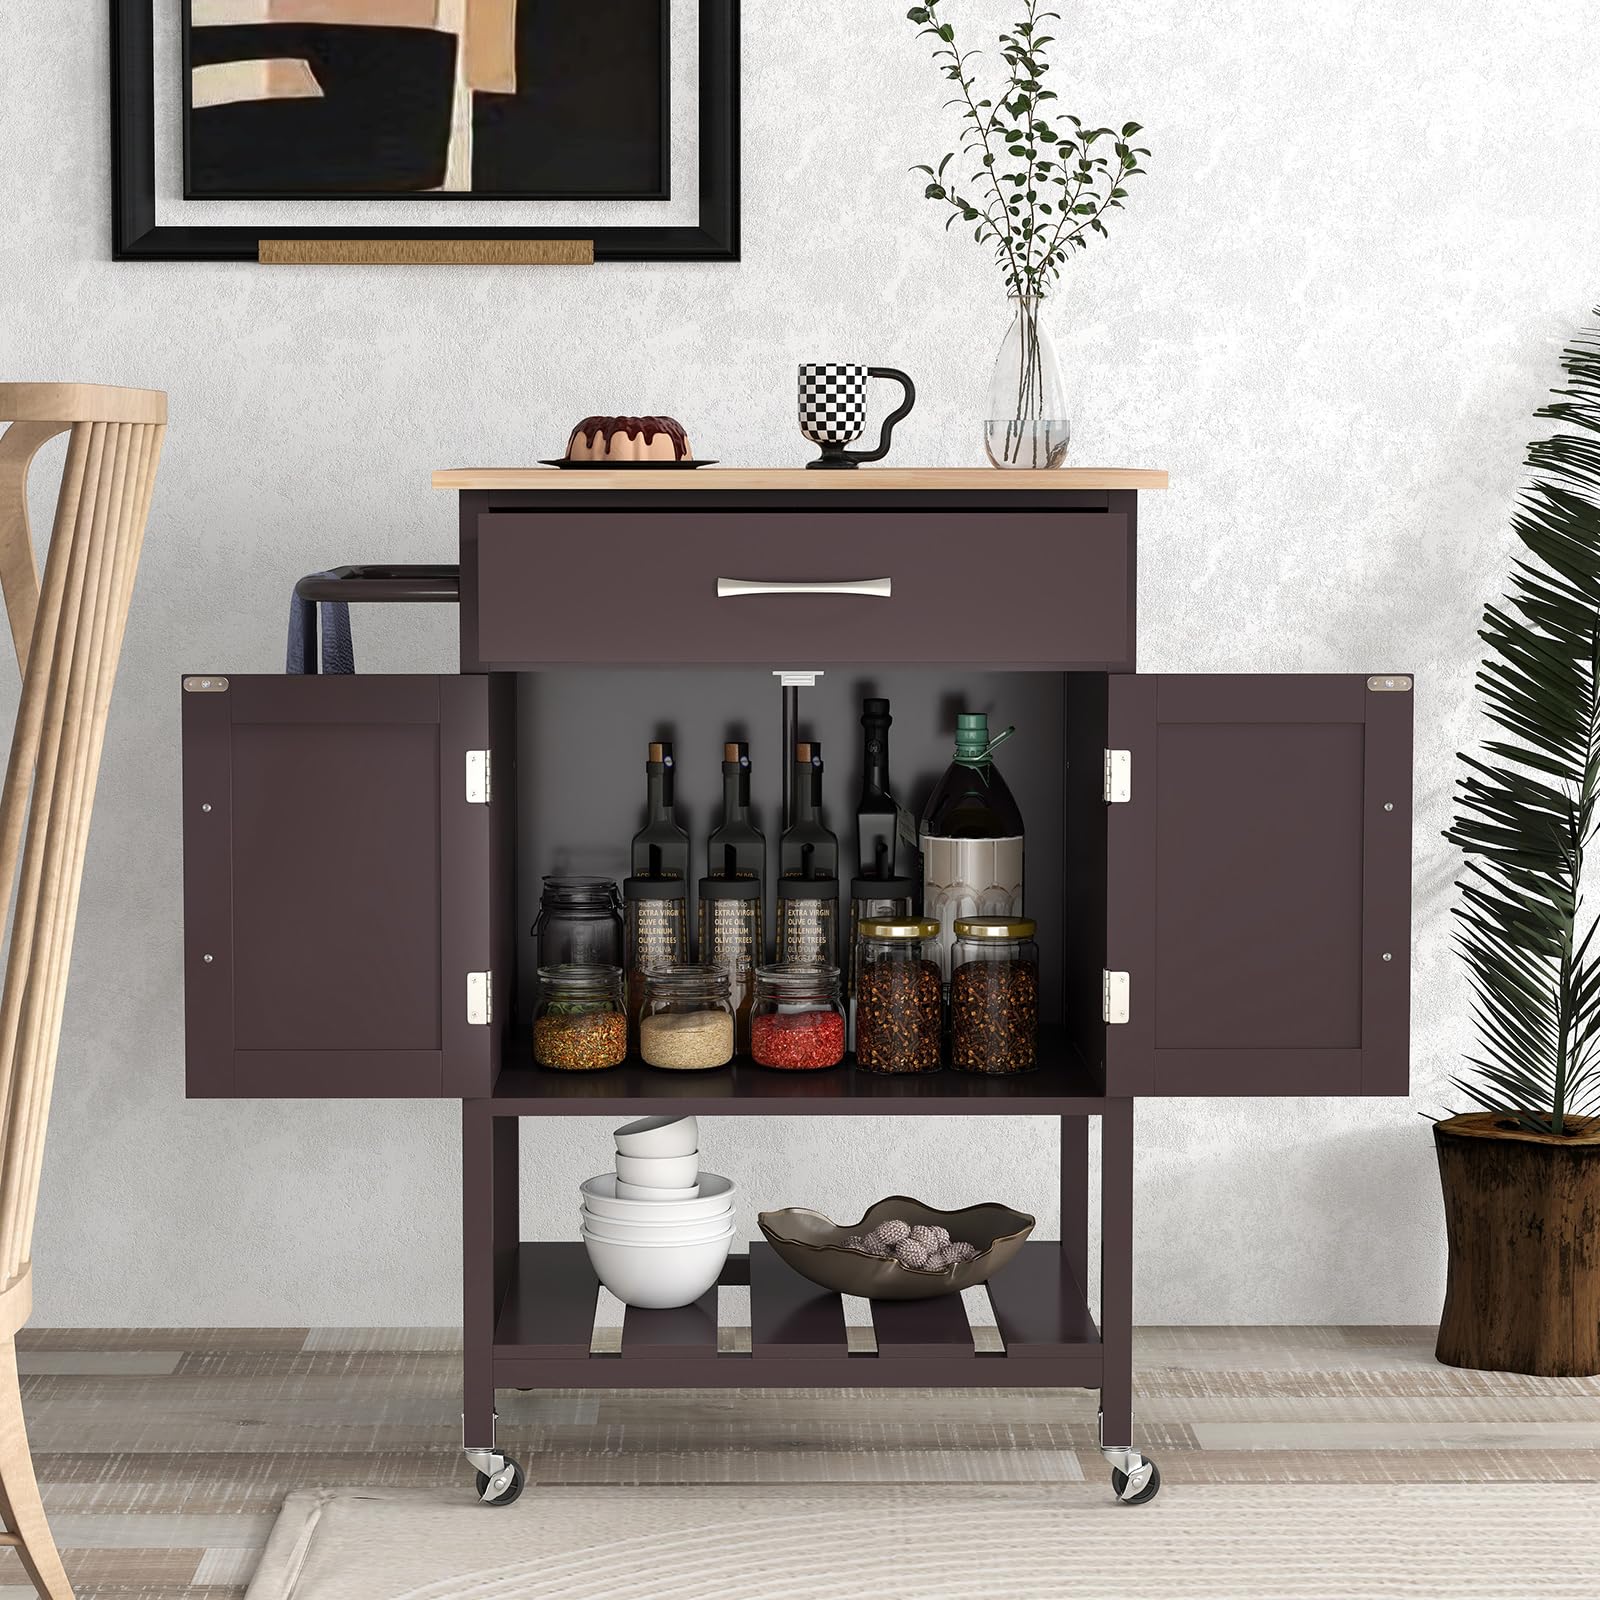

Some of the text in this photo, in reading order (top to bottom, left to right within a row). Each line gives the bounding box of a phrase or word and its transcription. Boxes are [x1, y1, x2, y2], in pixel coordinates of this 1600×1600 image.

[638, 909, 658, 917] EXTRA
[714, 909, 735, 917] EXTRA
[788, 909, 830, 917] EXTRA VIRGIN
[638, 918, 669, 926] OLIVE OIL
[714, 918, 745, 926] OLIVE OIL
[788, 918, 817, 926] OLIVE OIL
[638, 927, 673, 935] MILLENIUM
[714, 927, 749, 935] MILLENIUM
[788, 927, 822, 935] MILLENIUM
[638, 936, 677, 944] OLIVE TREES
[714, 936, 753, 944] OLIVE TREES
[787, 936, 827, 944] OLIVE TREES
